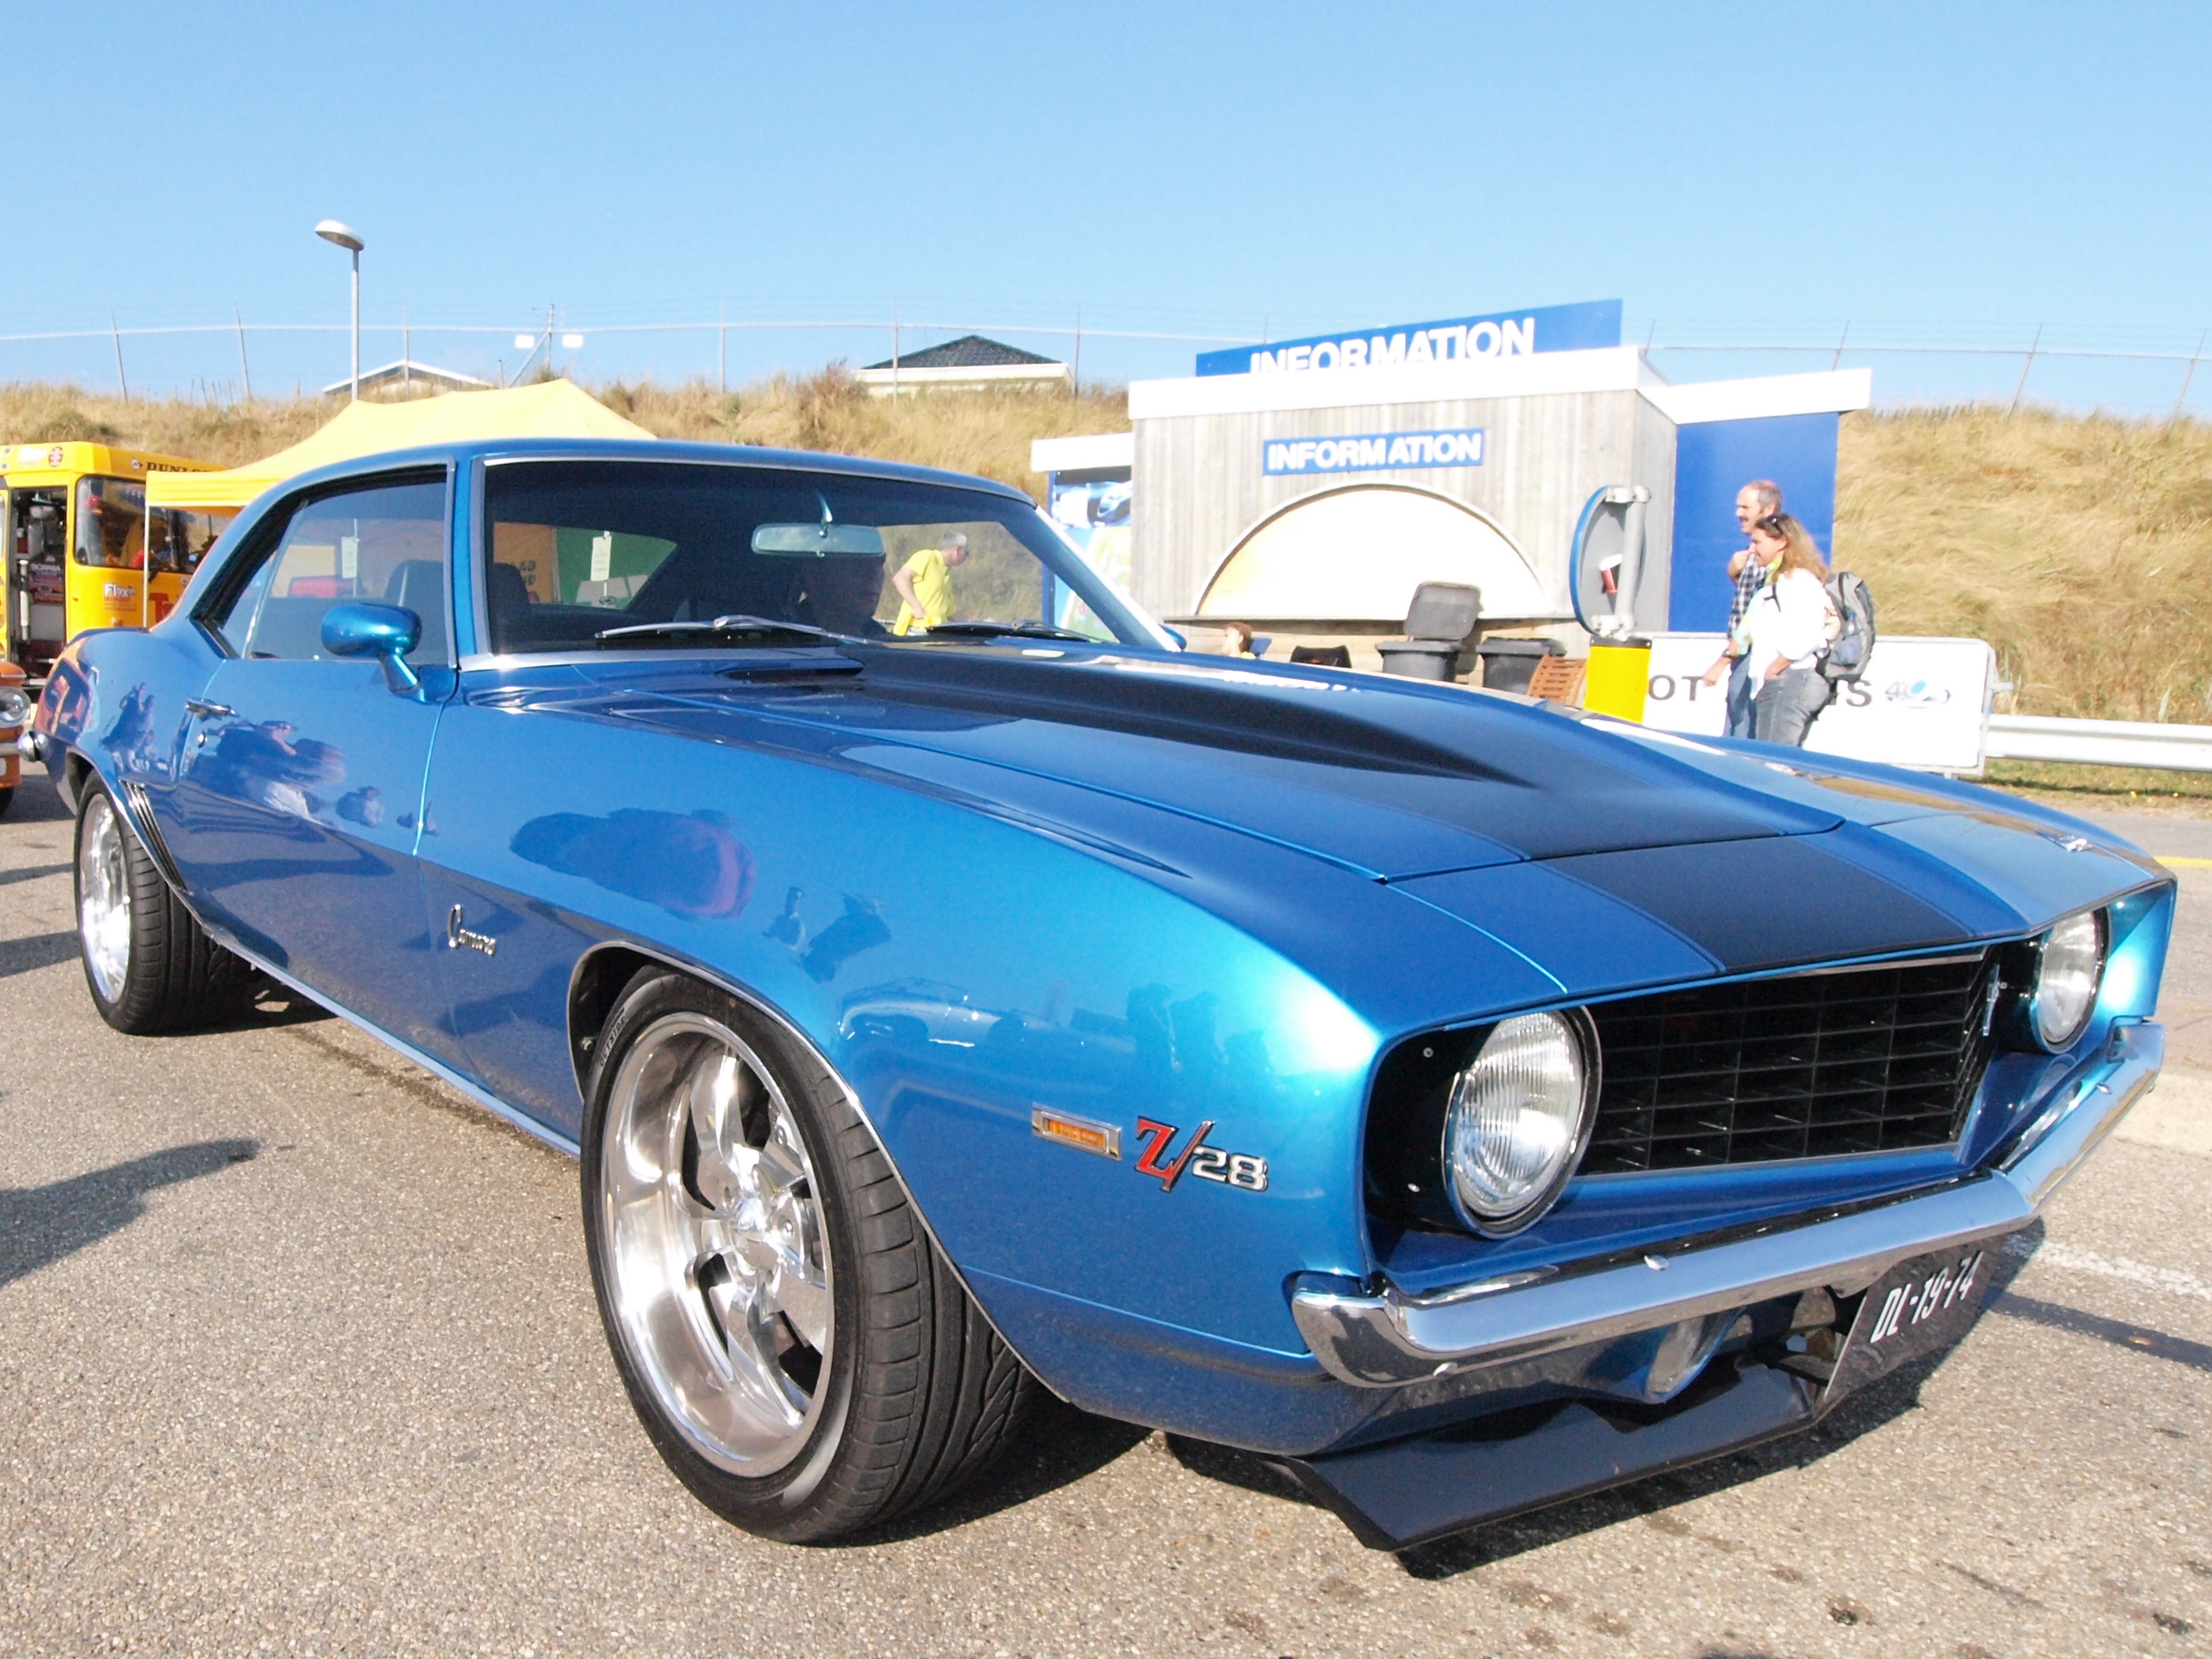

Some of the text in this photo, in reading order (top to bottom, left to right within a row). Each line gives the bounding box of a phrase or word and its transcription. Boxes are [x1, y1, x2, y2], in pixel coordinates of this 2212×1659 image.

[1250, 317, 1535, 374] INFORMATION
[1267, 433, 1482, 471] INFORMATION
[1134, 1115, 1269, 1193] Z/28
[1870, 1251, 1984, 1344] DL-19-74
